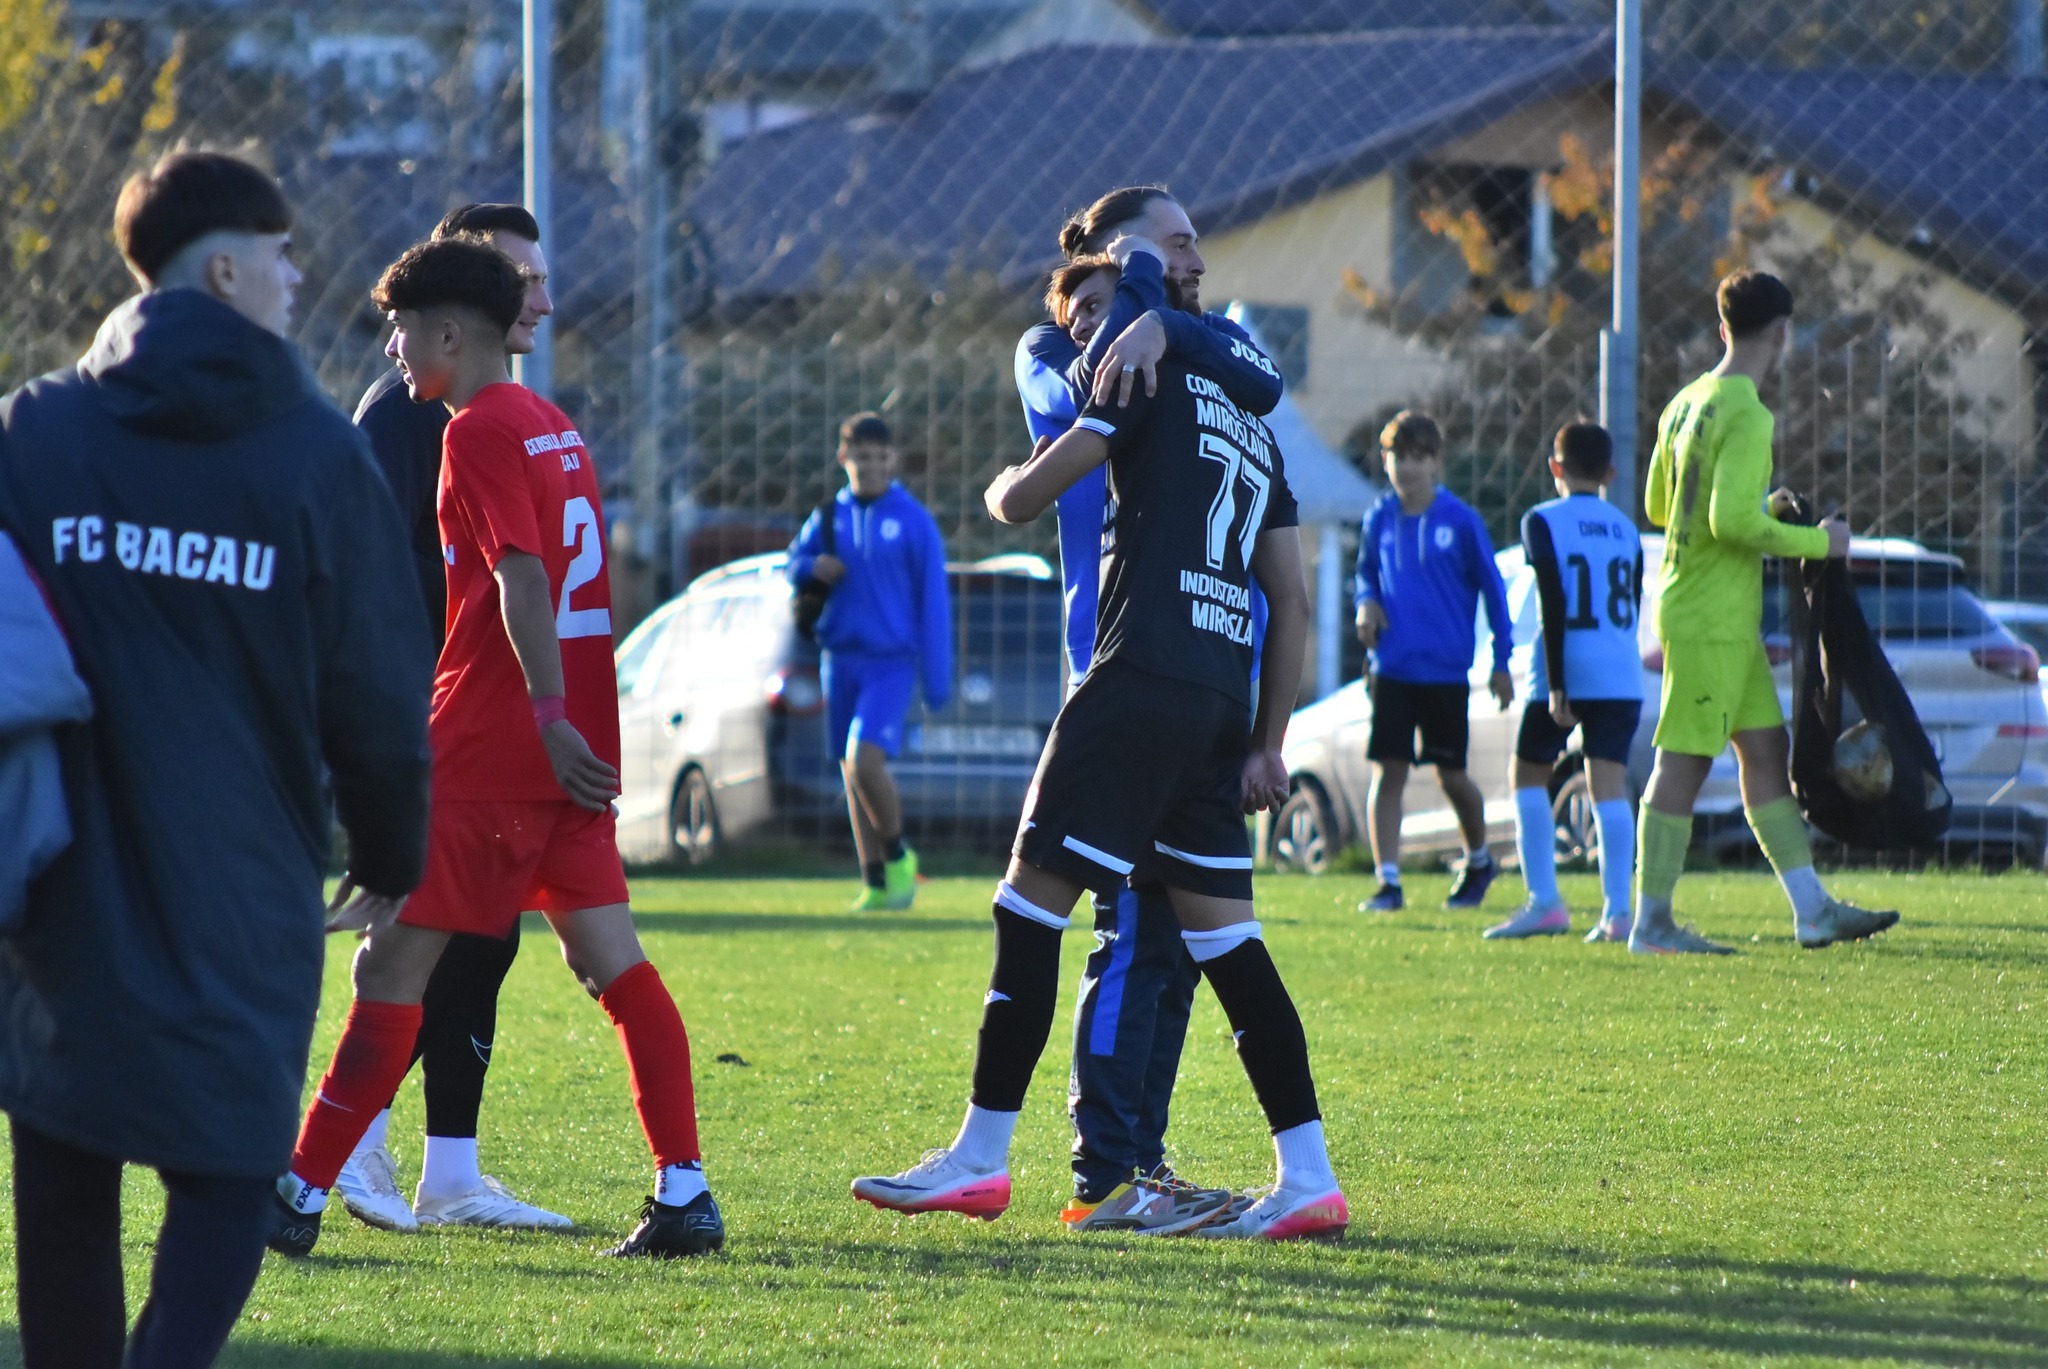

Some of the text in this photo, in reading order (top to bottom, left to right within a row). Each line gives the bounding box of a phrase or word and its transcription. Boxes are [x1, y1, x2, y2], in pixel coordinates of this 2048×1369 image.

[1196, 397, 1273, 472] MIROSLAVA
[1199, 432, 1270, 572] 77
[52, 515, 276, 591] FC BACAU
[556, 496, 612, 639] 2
[1180, 569, 1250, 611] INDUSTRIA
[1565, 552, 1634, 631] 18
